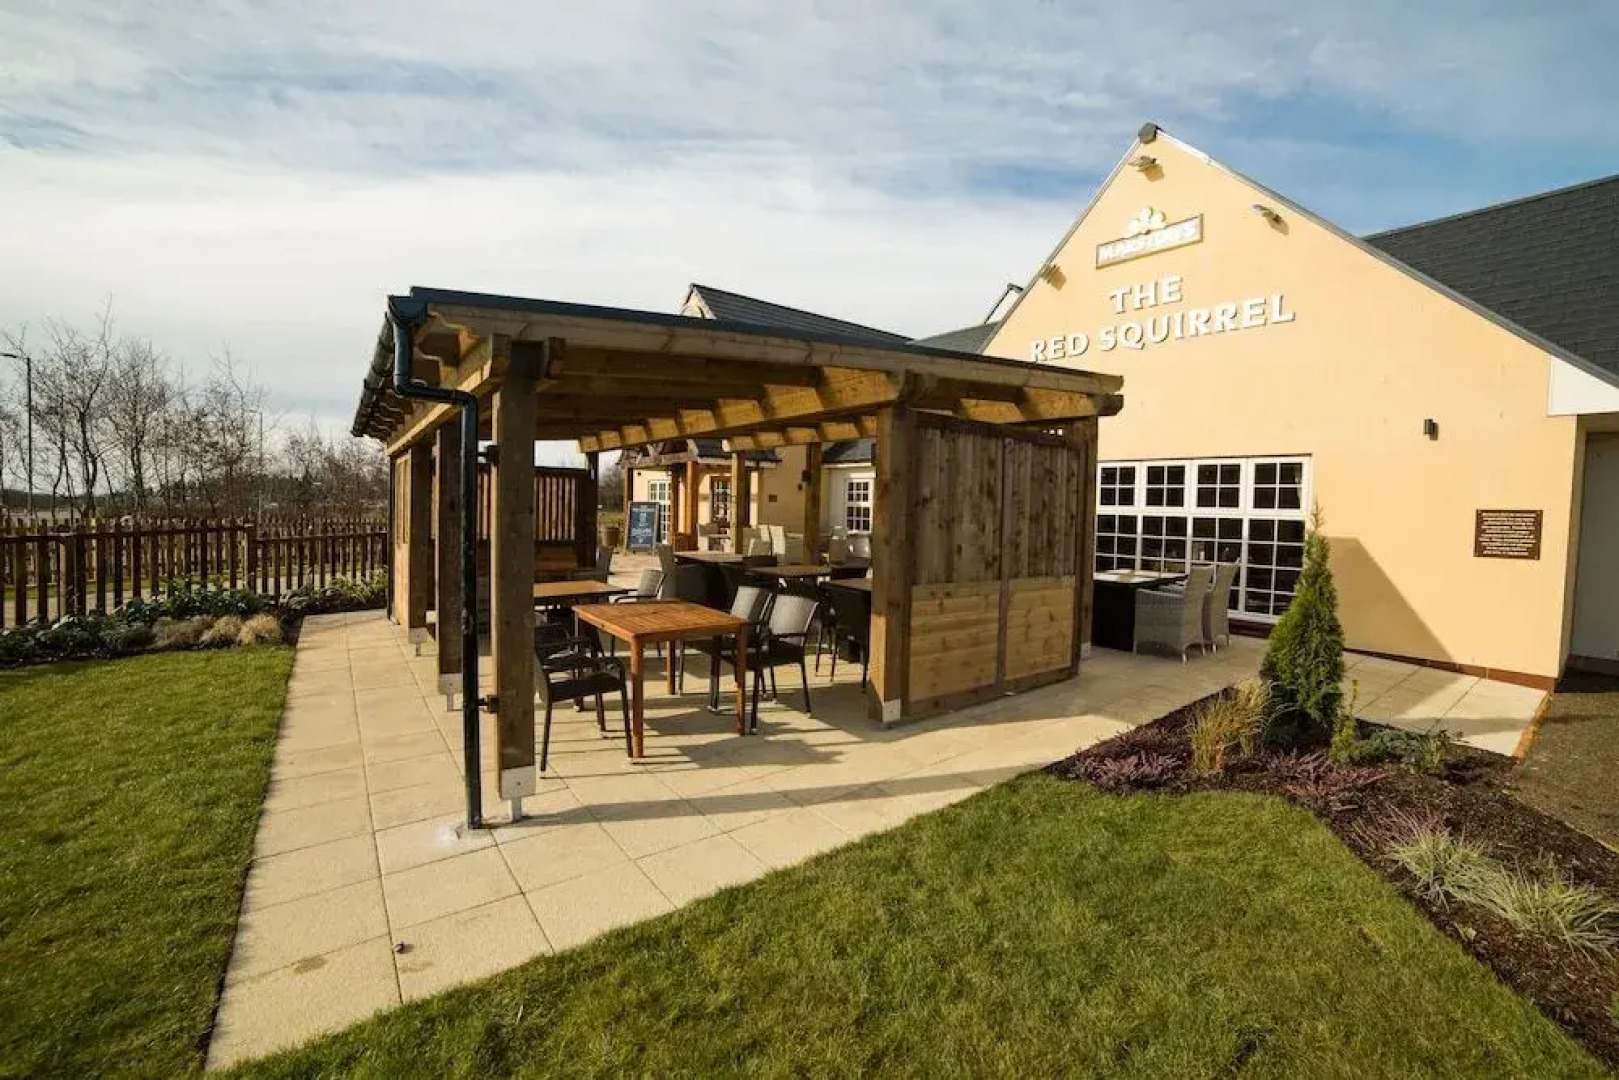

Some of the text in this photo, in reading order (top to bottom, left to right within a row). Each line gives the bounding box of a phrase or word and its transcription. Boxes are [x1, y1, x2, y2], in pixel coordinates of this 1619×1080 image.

[1110, 274, 1183, 314] THE
[1030, 293, 1296, 363] RED SQUIRREL
